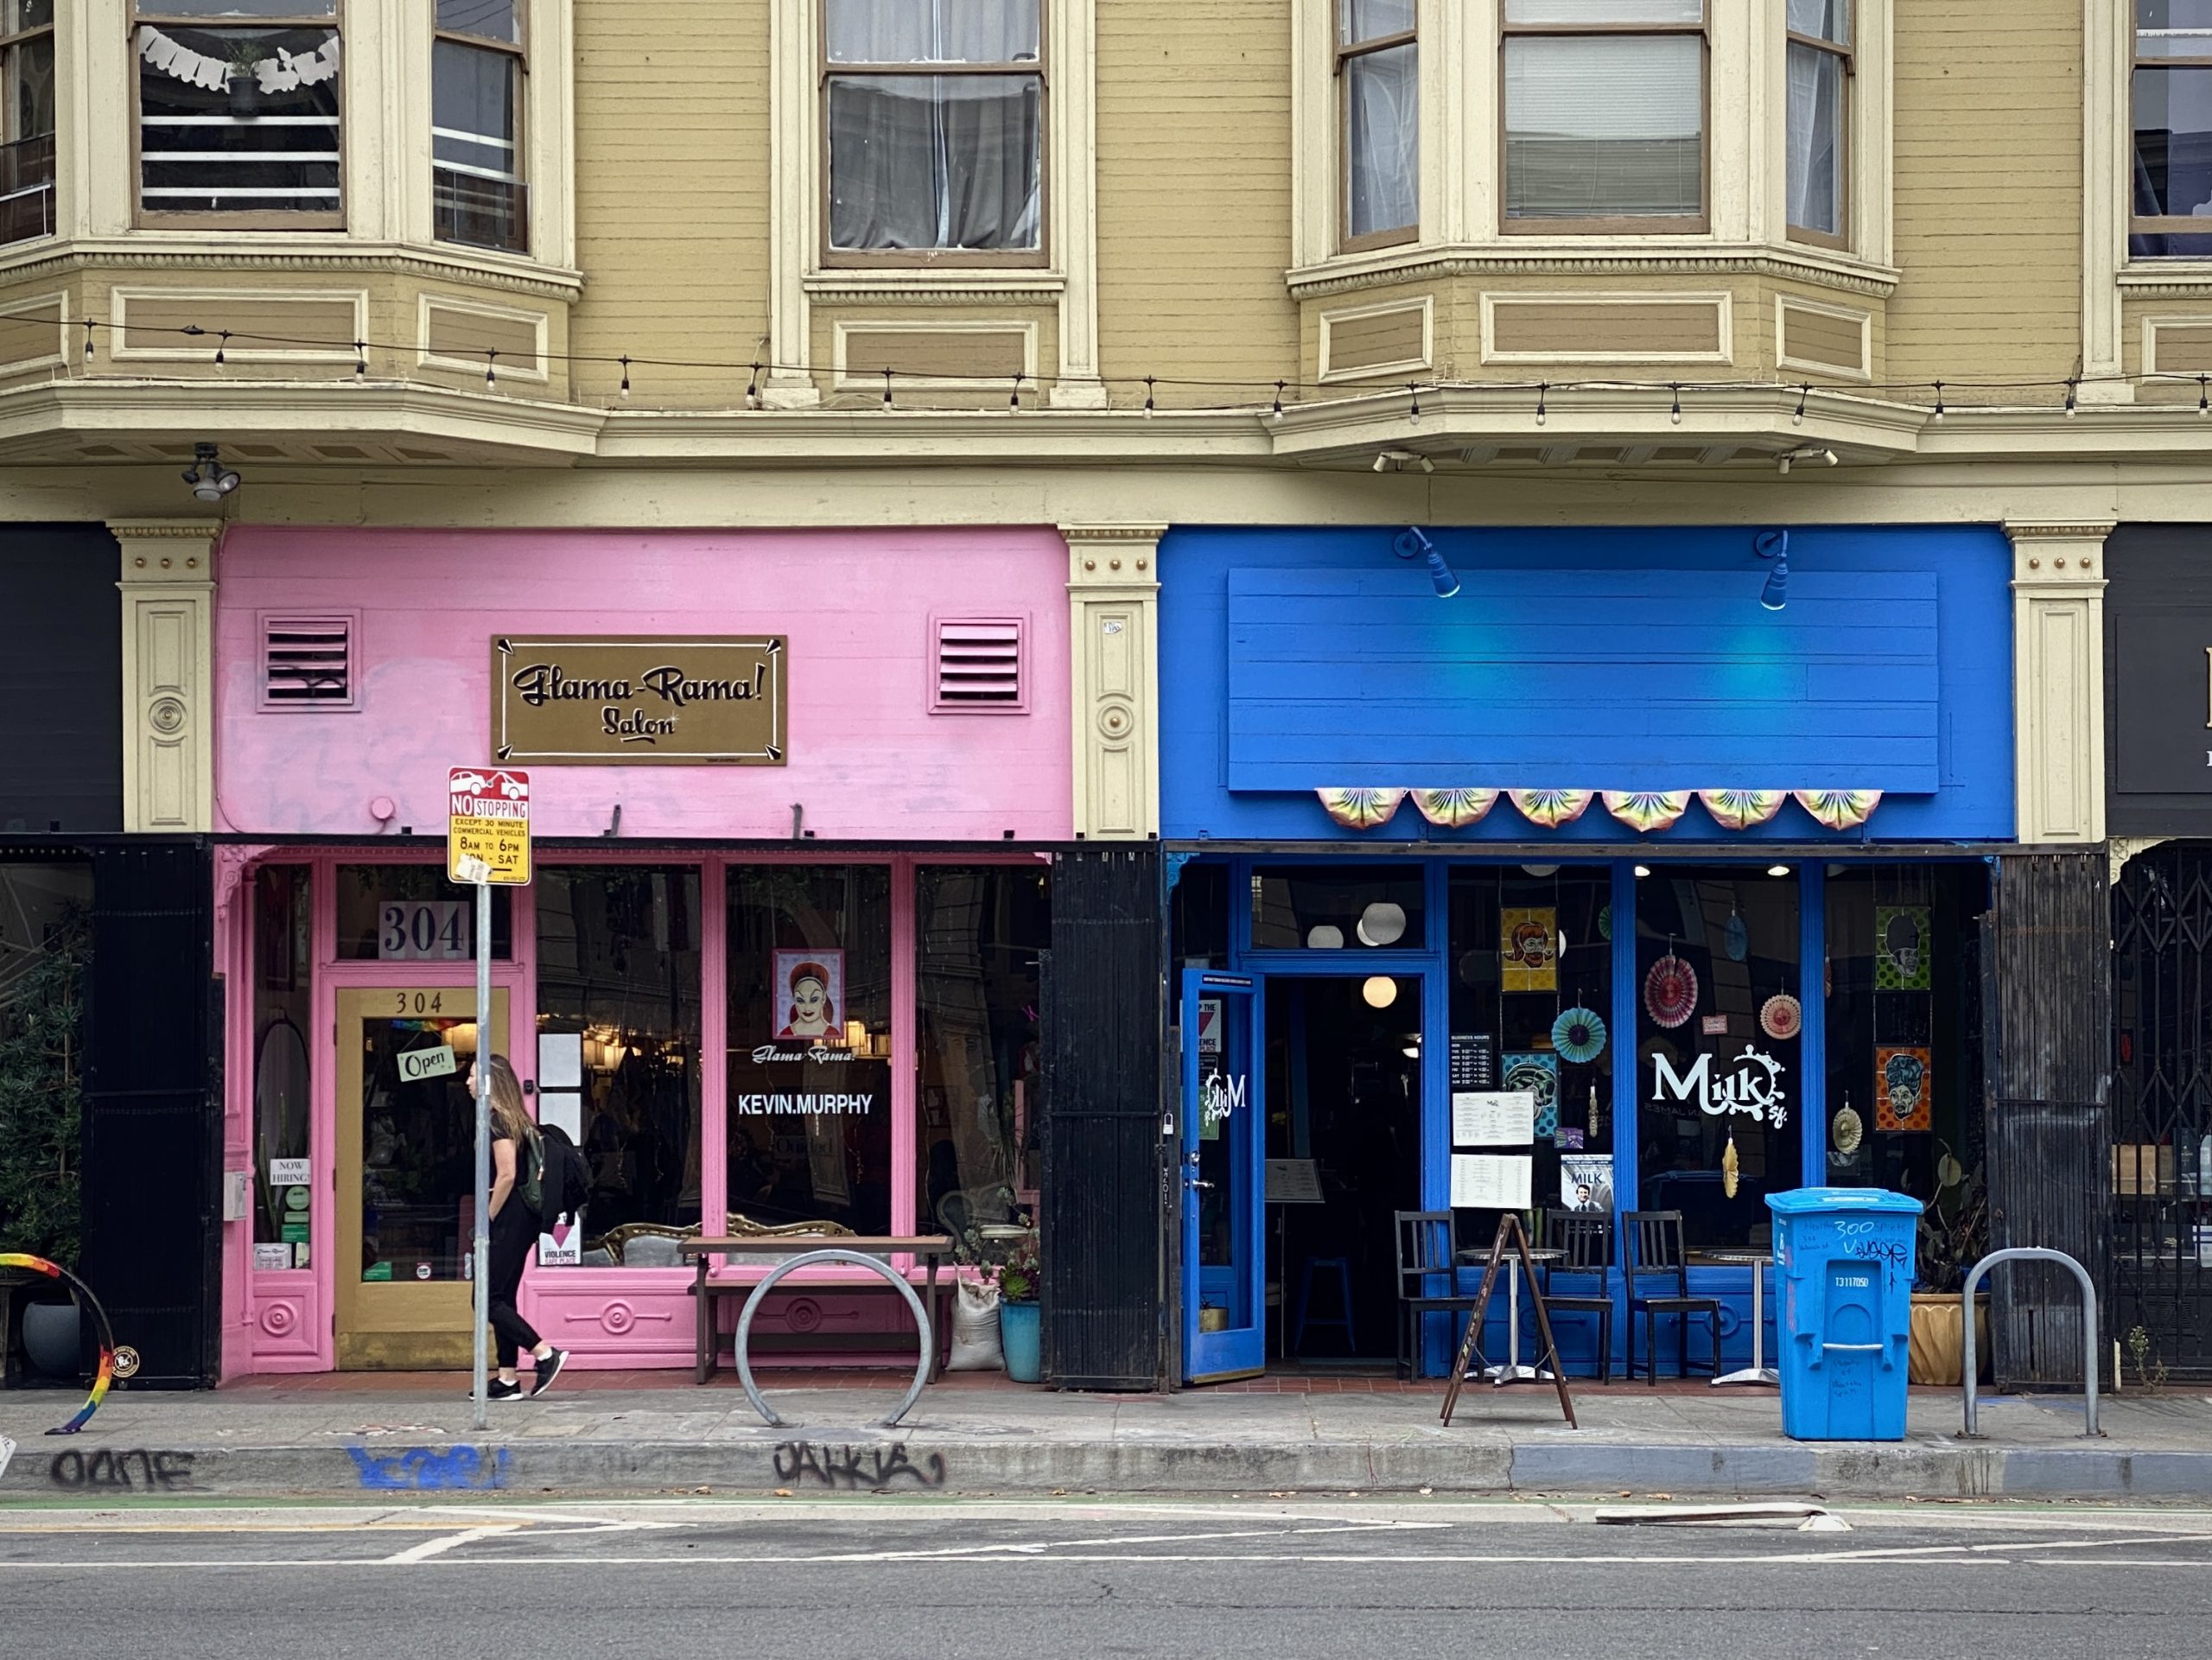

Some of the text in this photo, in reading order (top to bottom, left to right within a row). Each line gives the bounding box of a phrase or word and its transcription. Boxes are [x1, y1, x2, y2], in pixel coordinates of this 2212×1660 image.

[512, 664, 766, 706] Glama-Rama!
[601, 706, 676, 736] Salon
[451, 794, 525, 817] NO STOPPING
[461, 836, 519, 851] 8AM TO 6PM
[498, 855, 518, 864] SAT
[385, 906, 464, 951] 304
[397, 992, 442, 1014] 304
[405, 1051, 445, 1077] Open
[1651, 1053, 1777, 1116] Milk
[738, 1094, 873, 1115] KEVIN.MURPHY
[279, 1161, 304, 1170] NOW
[1571, 1173, 1603, 1184] MILK
[1834, 1220, 1874, 1239] 300
[544, 1250, 576, 1258] VIOLENCE
